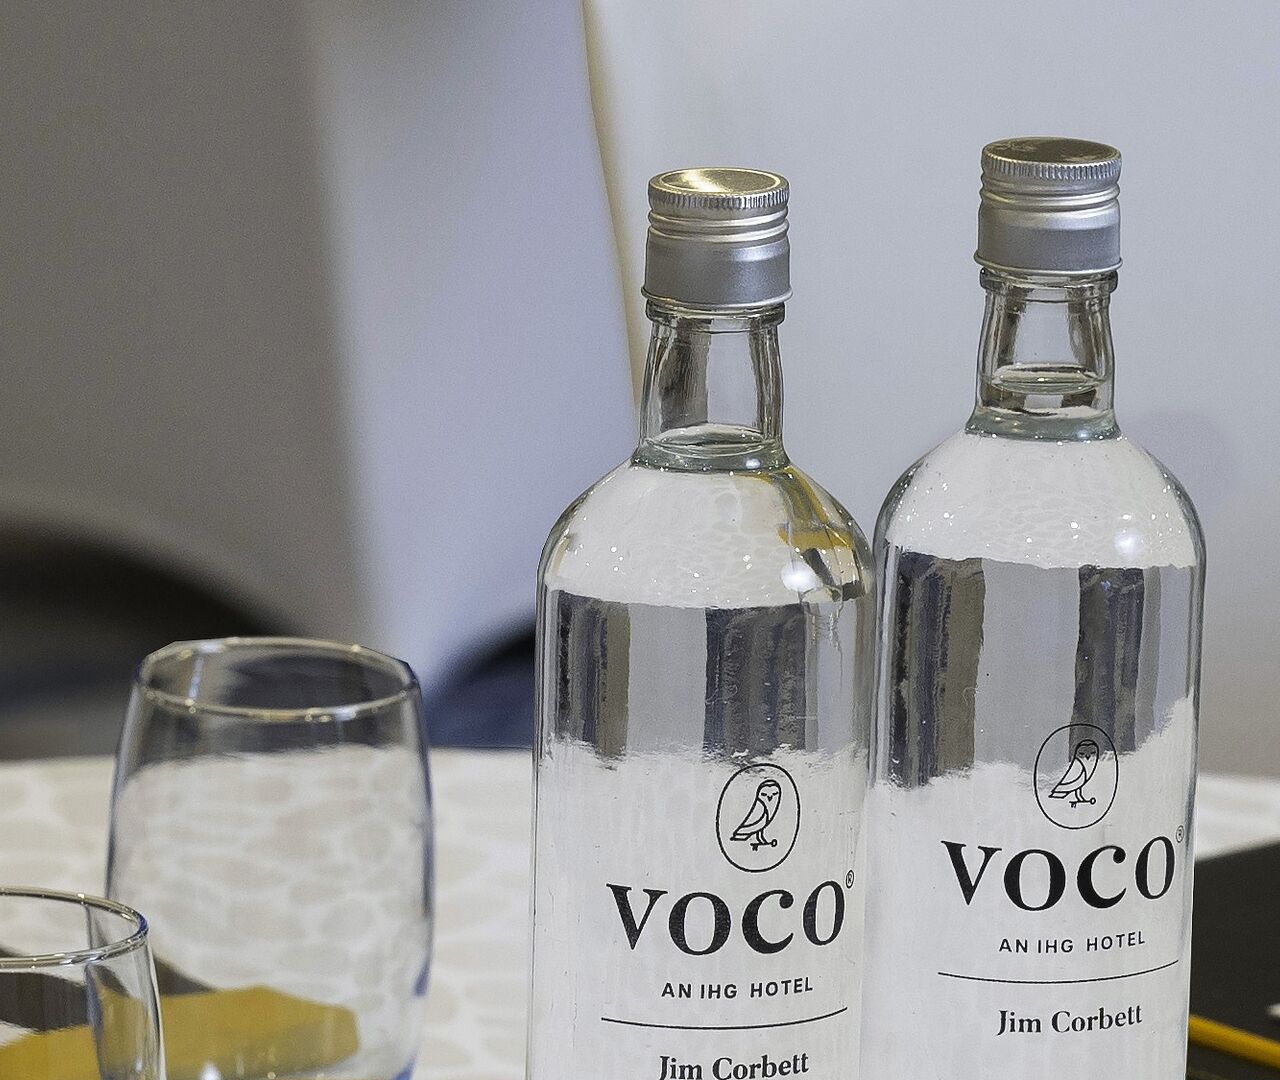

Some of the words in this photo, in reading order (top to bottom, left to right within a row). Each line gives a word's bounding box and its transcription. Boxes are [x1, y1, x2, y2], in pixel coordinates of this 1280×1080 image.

[998, 937, 1029, 954] AN
[1037, 939, 1075, 954] IHG
[1086, 930, 1146, 952] HOTEL
[660, 982, 693, 999] AN
[699, 983, 738, 1000] IHG
[749, 976, 814, 998] HOTEL
[995, 1009, 1042, 1037] Jim
[1050, 1005, 1144, 1034] Corbett
